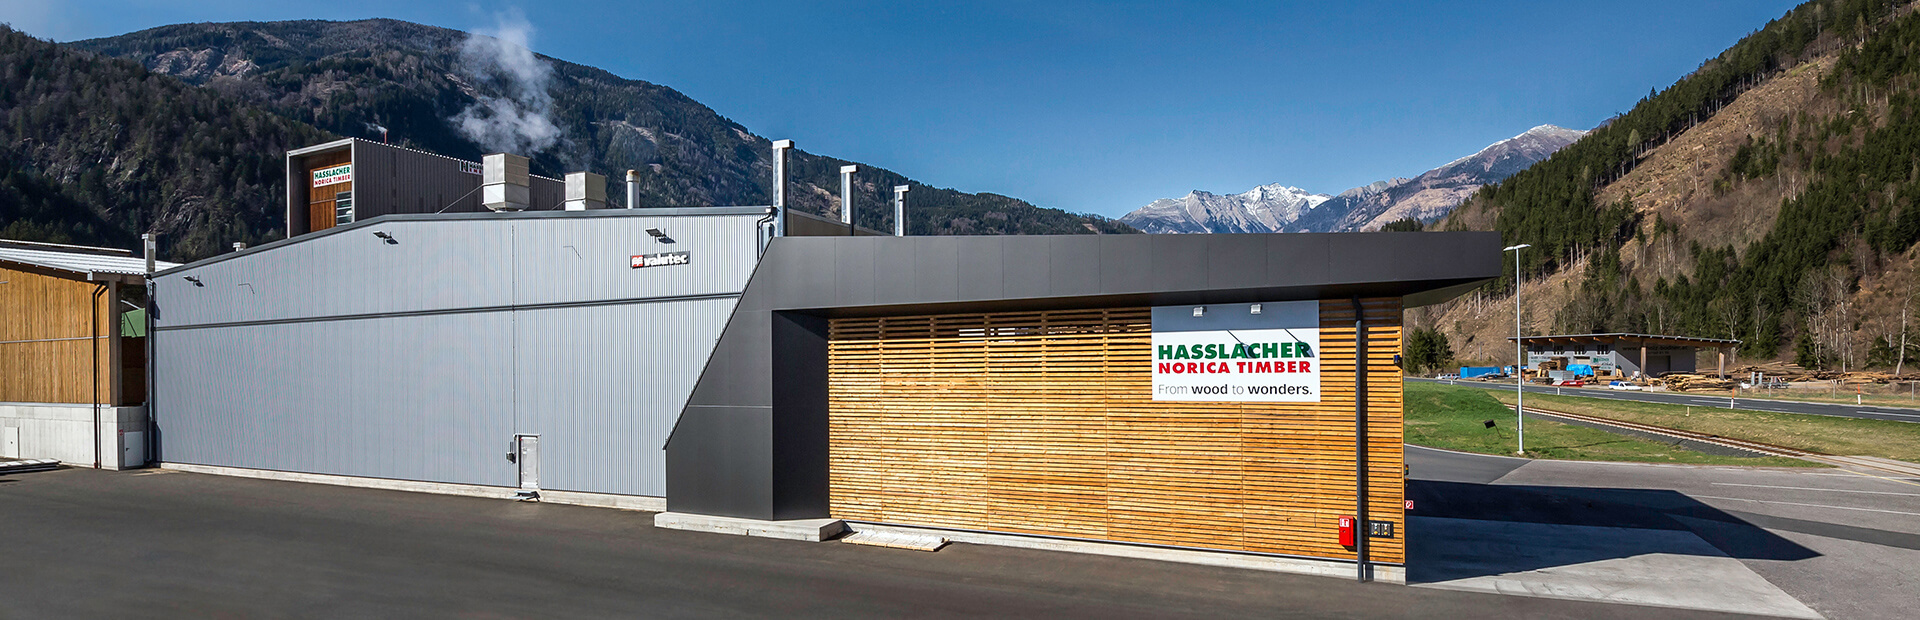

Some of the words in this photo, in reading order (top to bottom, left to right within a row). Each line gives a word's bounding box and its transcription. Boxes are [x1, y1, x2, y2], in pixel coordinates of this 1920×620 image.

[314, 166, 350, 179] HASSLACHER
[333, 174, 350, 182] TIMBER
[644, 253, 688, 266] valutec
[1158, 342, 1312, 360] HASSLACHER
[1158, 361, 1231, 374] NORICA
[1236, 360, 1312, 374] TIMBER
[1158, 384, 1188, 395] From
[1191, 383, 1228, 395] wood
[1232, 384, 1245, 395] to
[1247, 383, 1313, 395] wonders.
